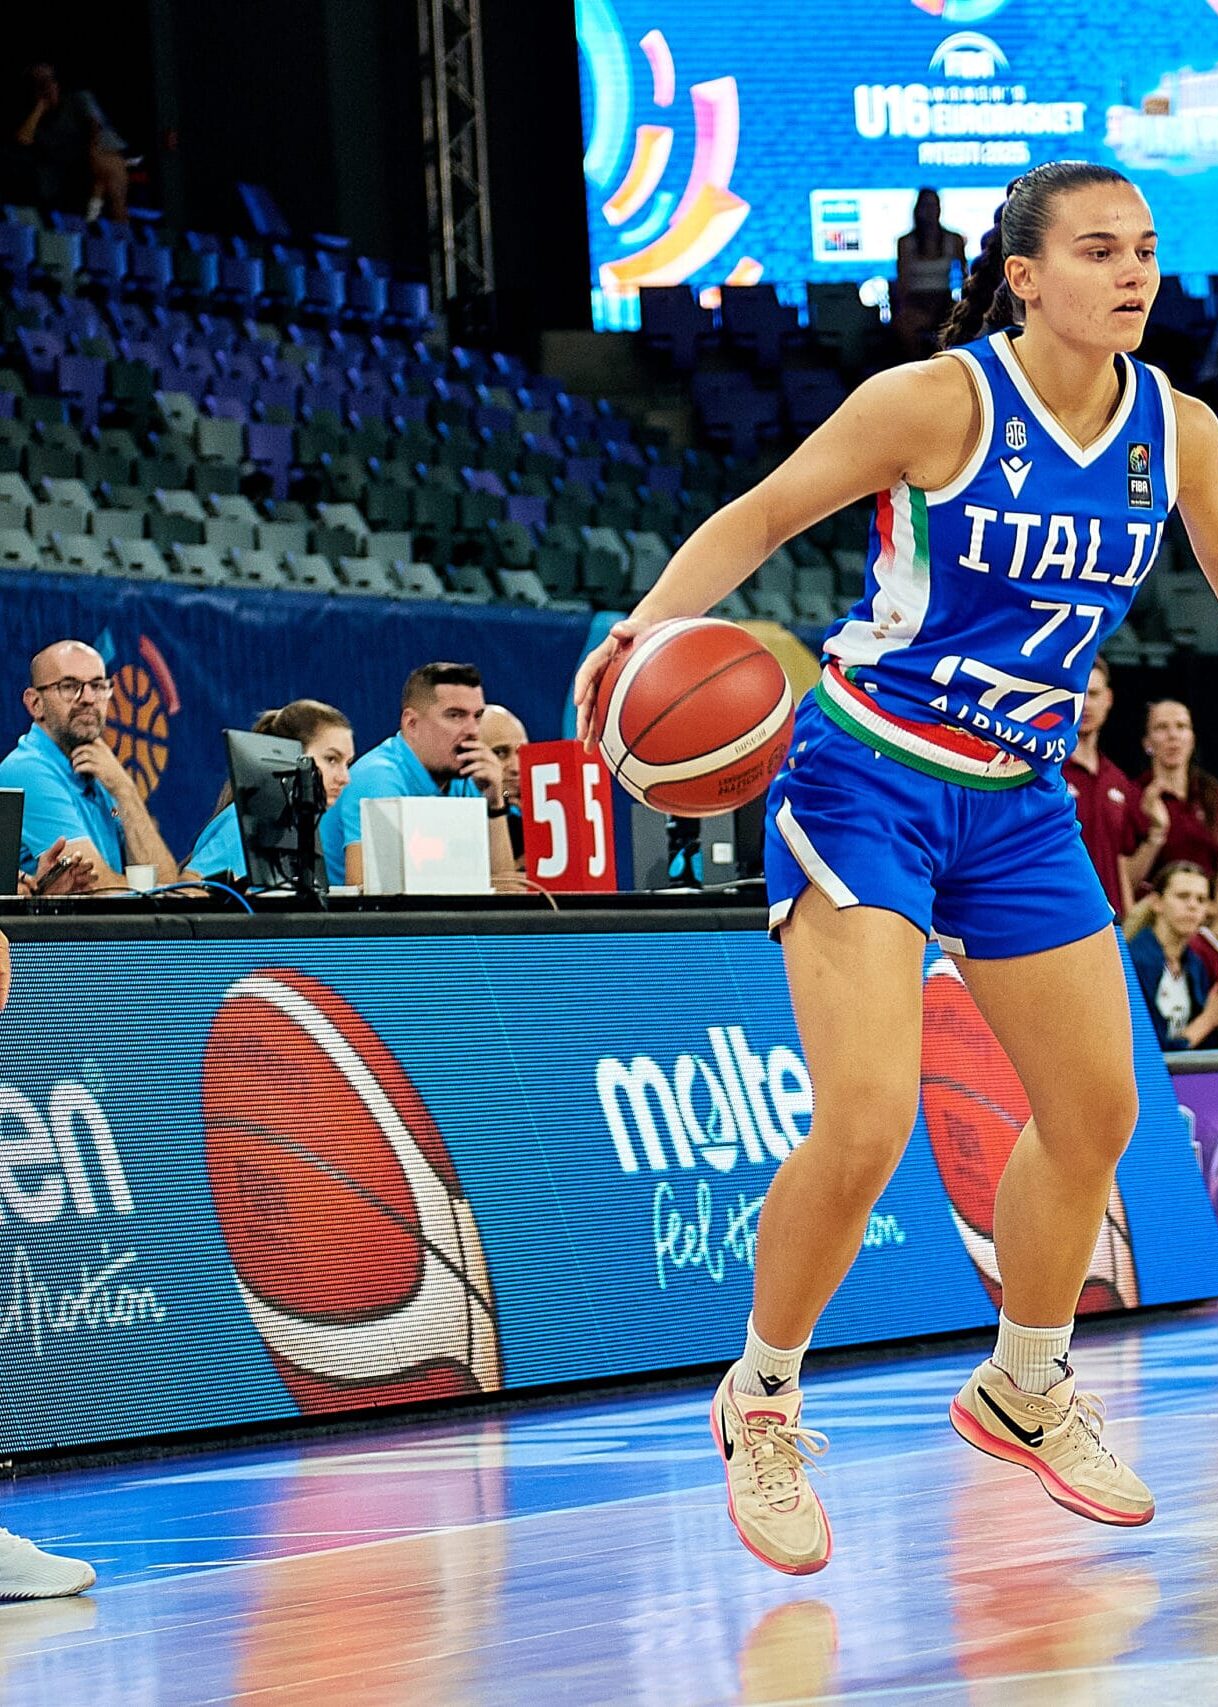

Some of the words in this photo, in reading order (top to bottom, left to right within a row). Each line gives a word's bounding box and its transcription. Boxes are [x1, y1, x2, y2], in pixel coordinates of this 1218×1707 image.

[854, 83, 931, 138] U16
[1130, 479, 1149, 494] FIBA
[1020, 600, 1105, 669] 77
[928, 694, 1067, 763] AIRWAYS
[532, 762, 569, 878] 5
[596, 1026, 815, 1173] molte
